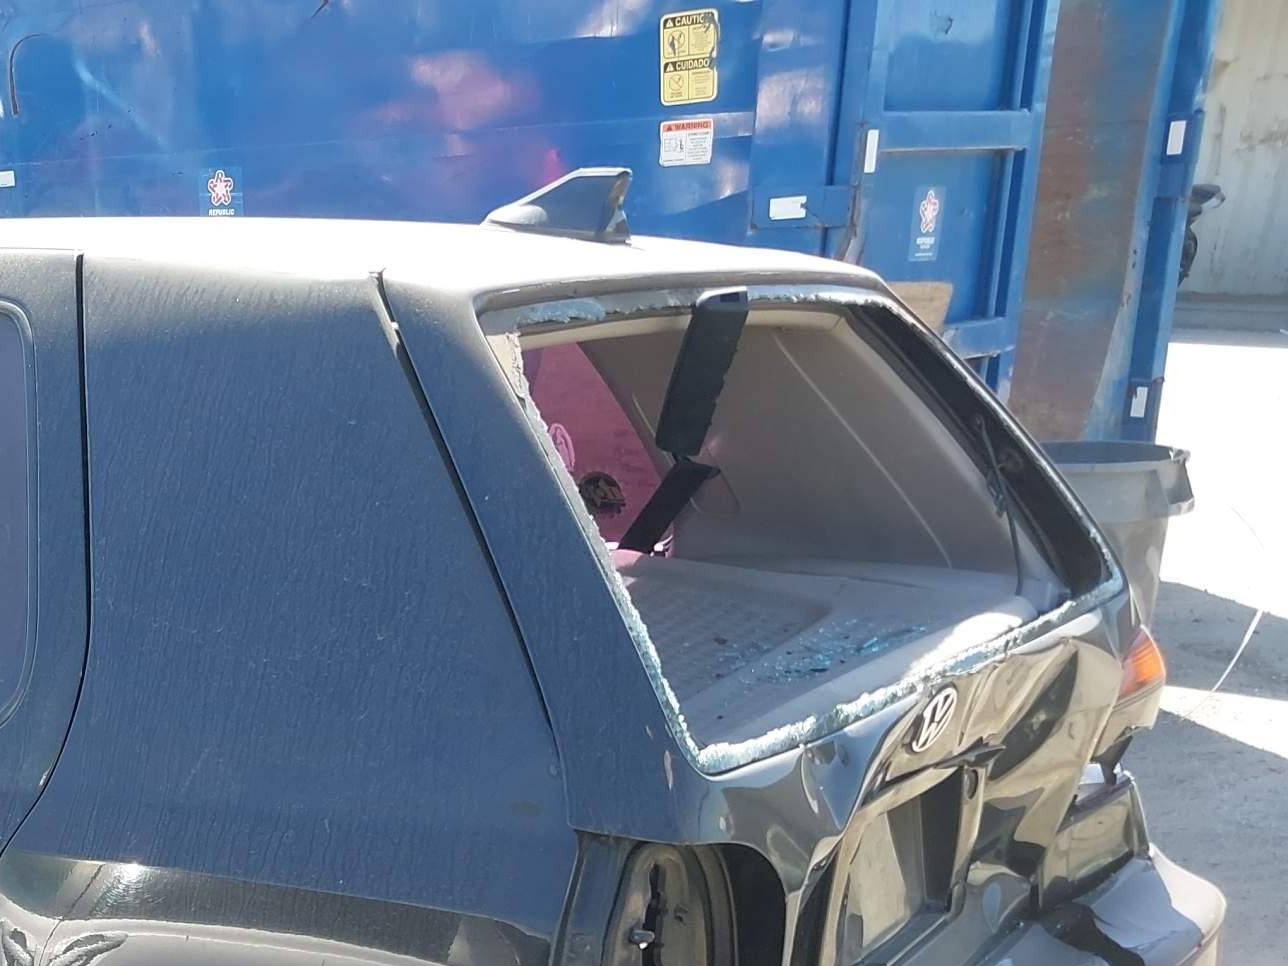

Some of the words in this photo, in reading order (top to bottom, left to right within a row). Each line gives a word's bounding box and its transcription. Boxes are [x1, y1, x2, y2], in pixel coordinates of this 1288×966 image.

[674, 13, 712, 27] CAUTIO
[675, 58, 710, 70] CUIDADO
[674, 121, 710, 131] WARNING
